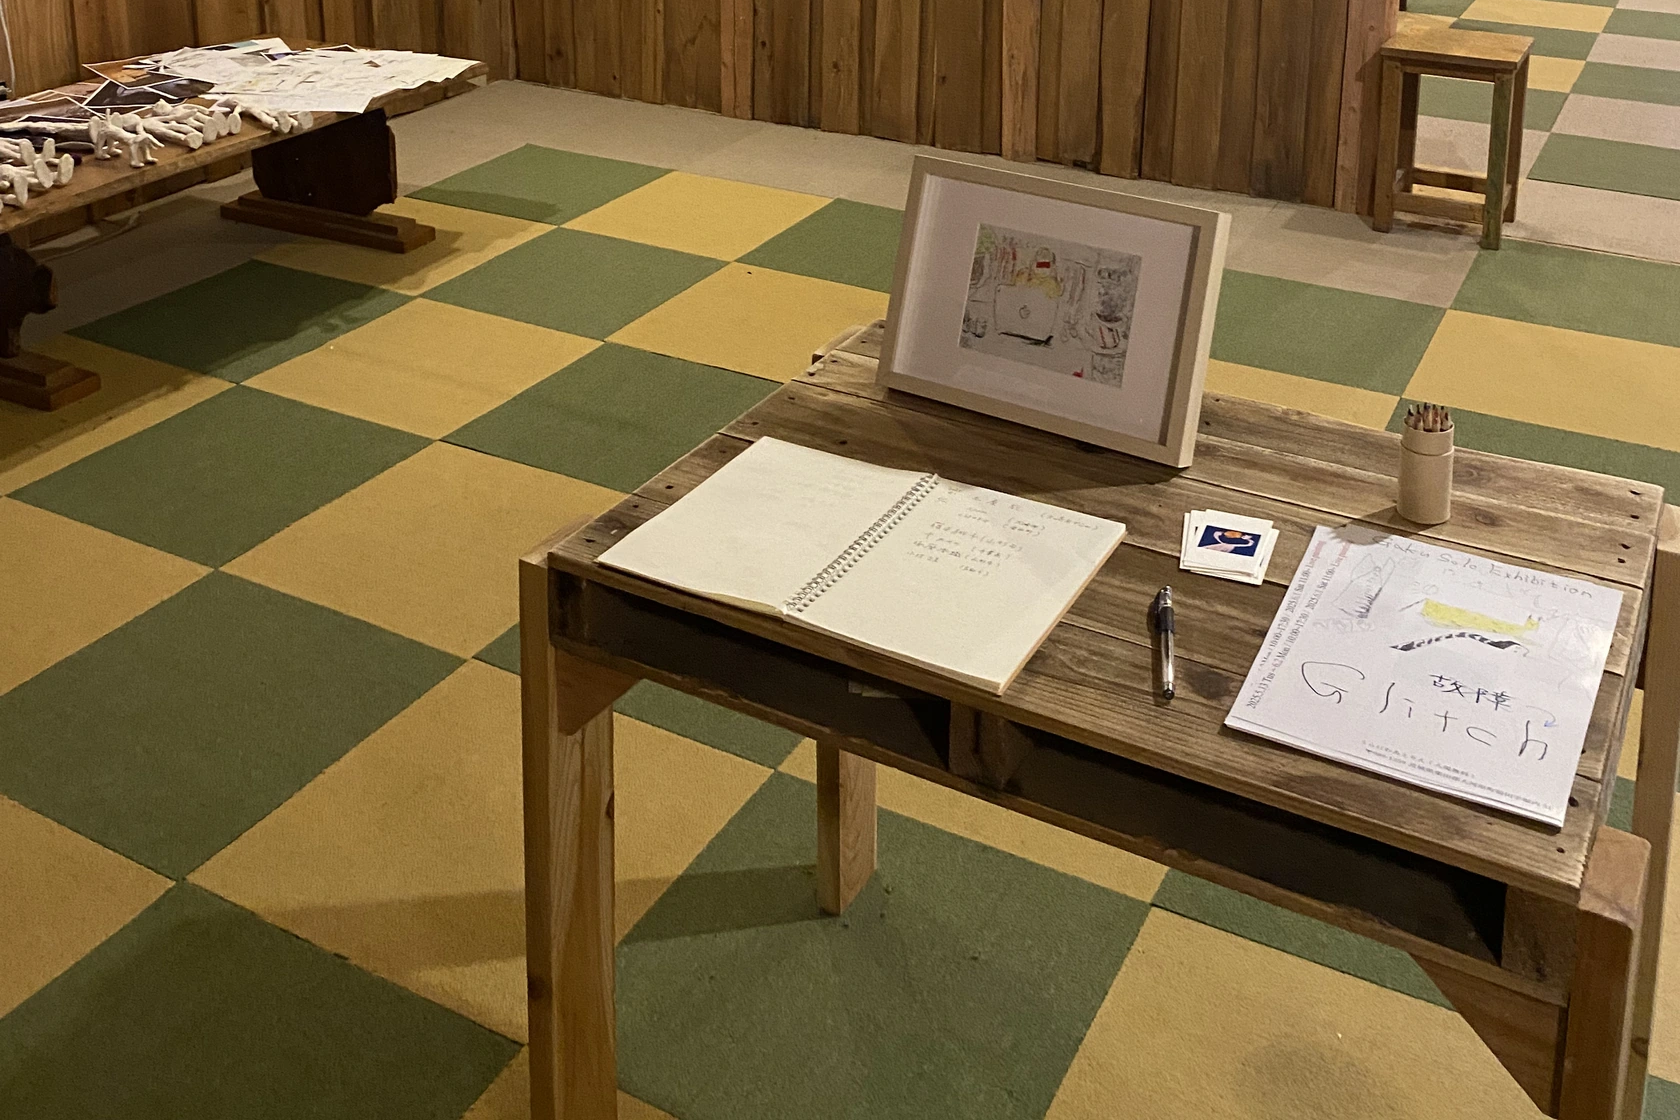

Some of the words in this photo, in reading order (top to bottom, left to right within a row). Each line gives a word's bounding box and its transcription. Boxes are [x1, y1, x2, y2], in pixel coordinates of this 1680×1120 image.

[1372, 535, 1430, 559] Gaku
[1439, 553, 1478, 570] Solo
[1489, 563, 1593, 599] Exhibition
